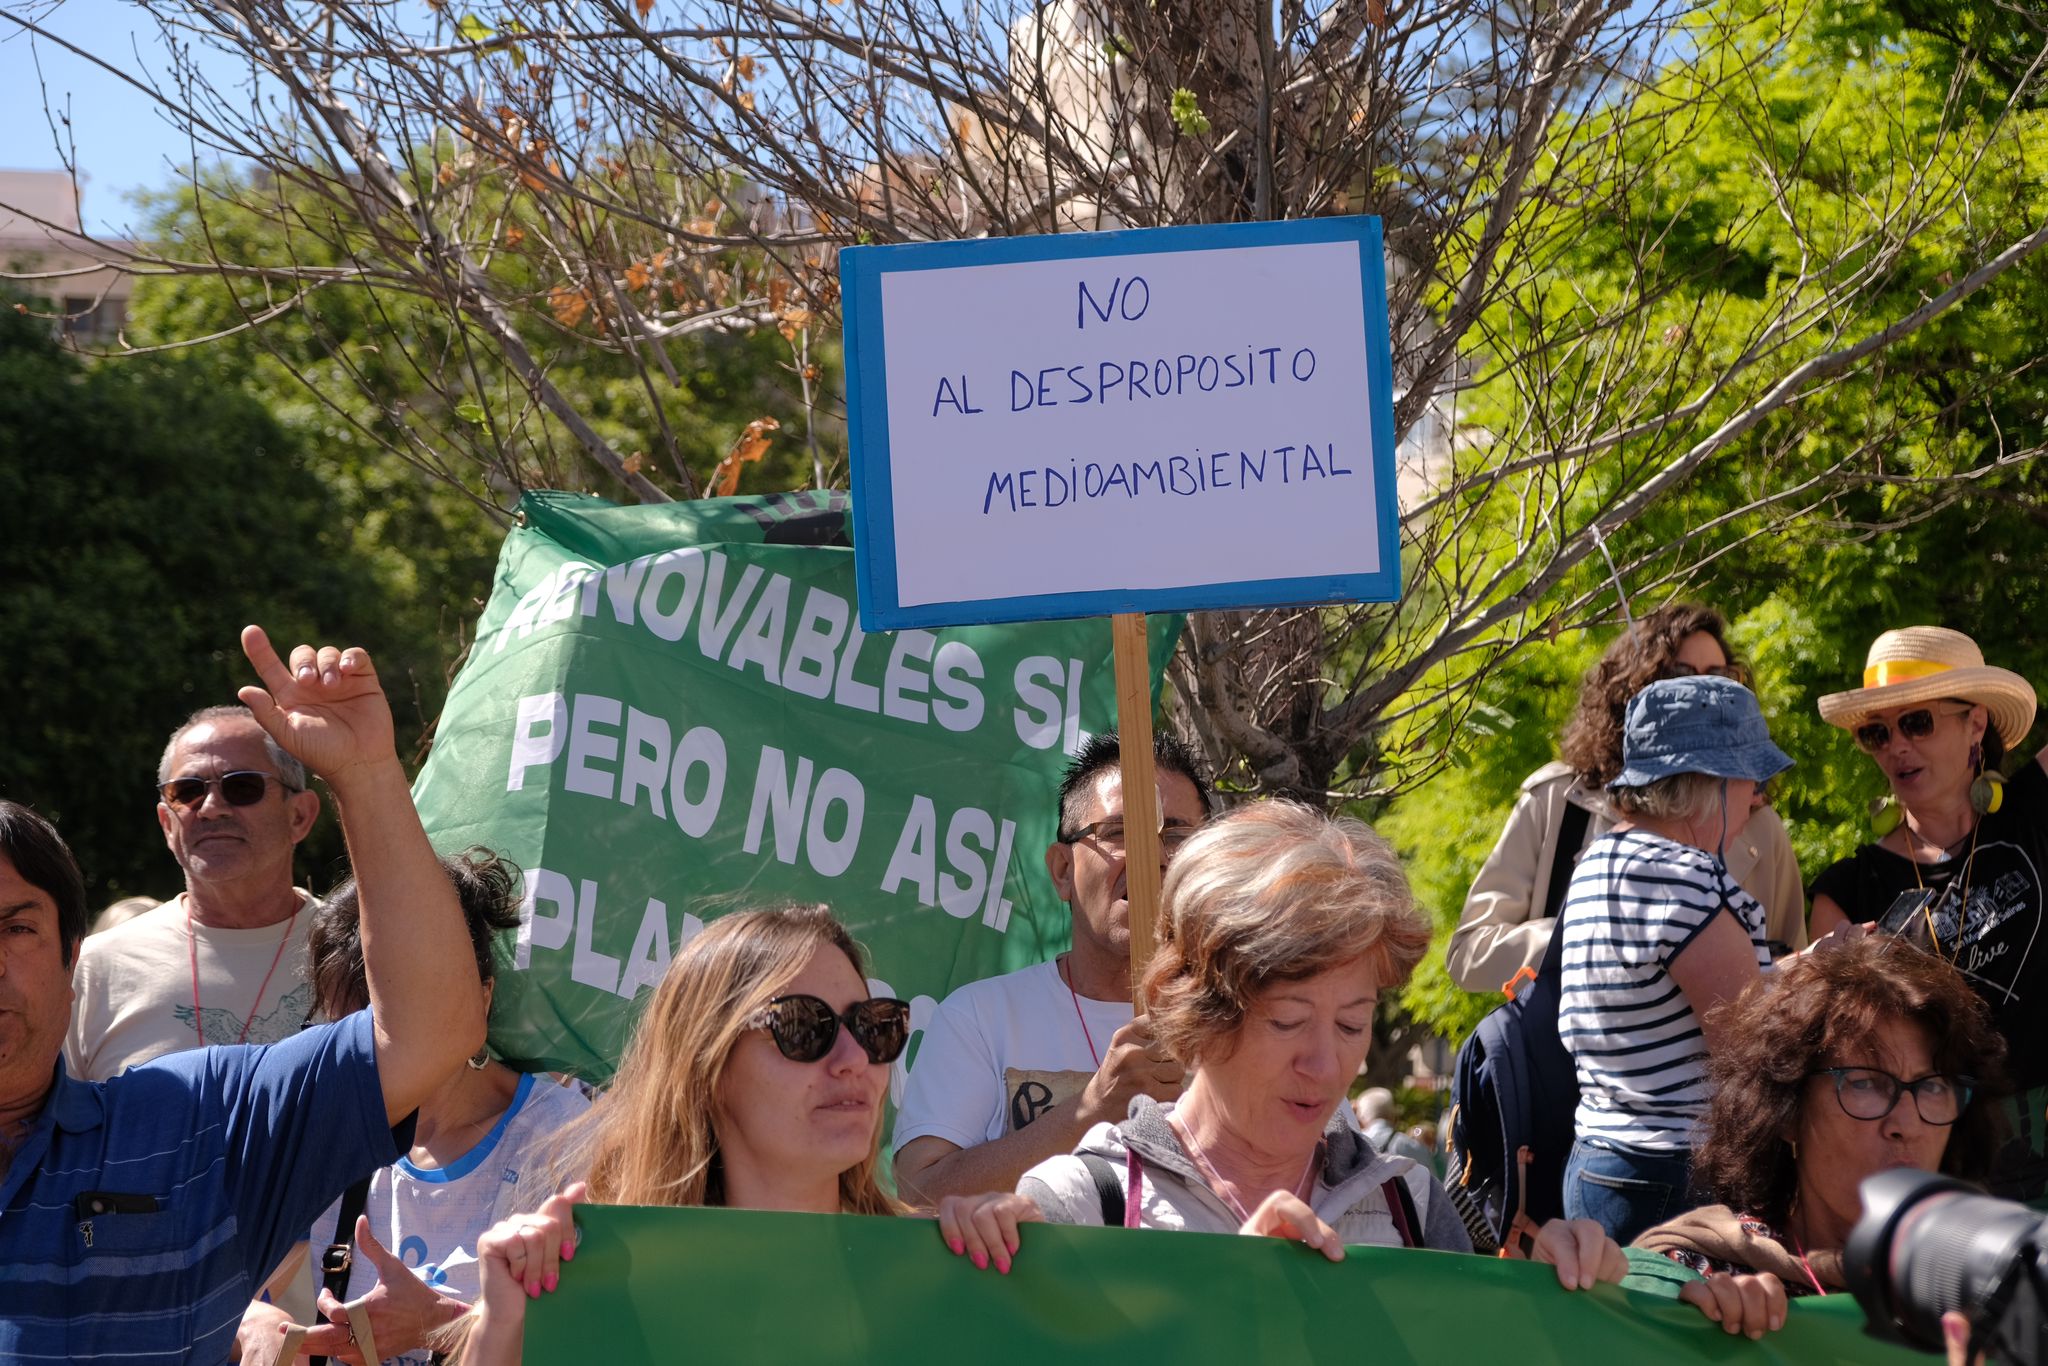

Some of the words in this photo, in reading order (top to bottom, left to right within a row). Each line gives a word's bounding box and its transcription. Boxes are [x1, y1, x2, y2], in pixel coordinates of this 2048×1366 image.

[1078, 276, 1149, 329] NO
[933, 375, 984, 417] AL
[1011, 345, 1316, 412] DESPROPOSITO
[983, 443, 1352, 515] MEDIOAMBIENTAL
[506, 691, 728, 839] PERO
[742, 734, 866, 878] NO
